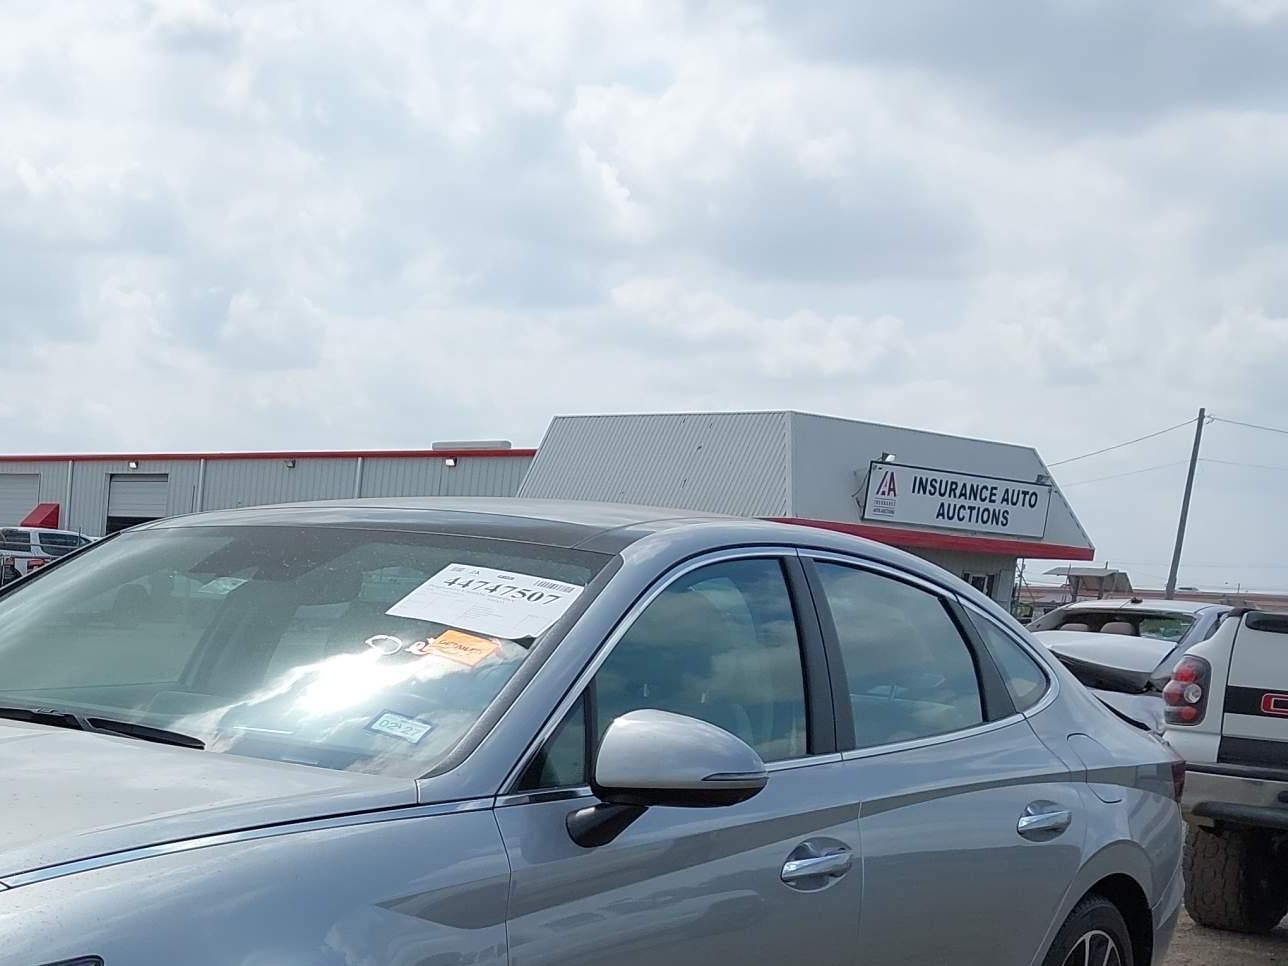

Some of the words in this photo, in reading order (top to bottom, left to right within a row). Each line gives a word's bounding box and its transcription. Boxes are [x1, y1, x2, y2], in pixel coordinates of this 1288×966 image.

[911, 475, 998, 504] INSURANCE
[1000, 487, 1039, 509] AUTO
[935, 501, 1010, 528] AUCTIONS
[443, 576, 561, 605] 44747507
